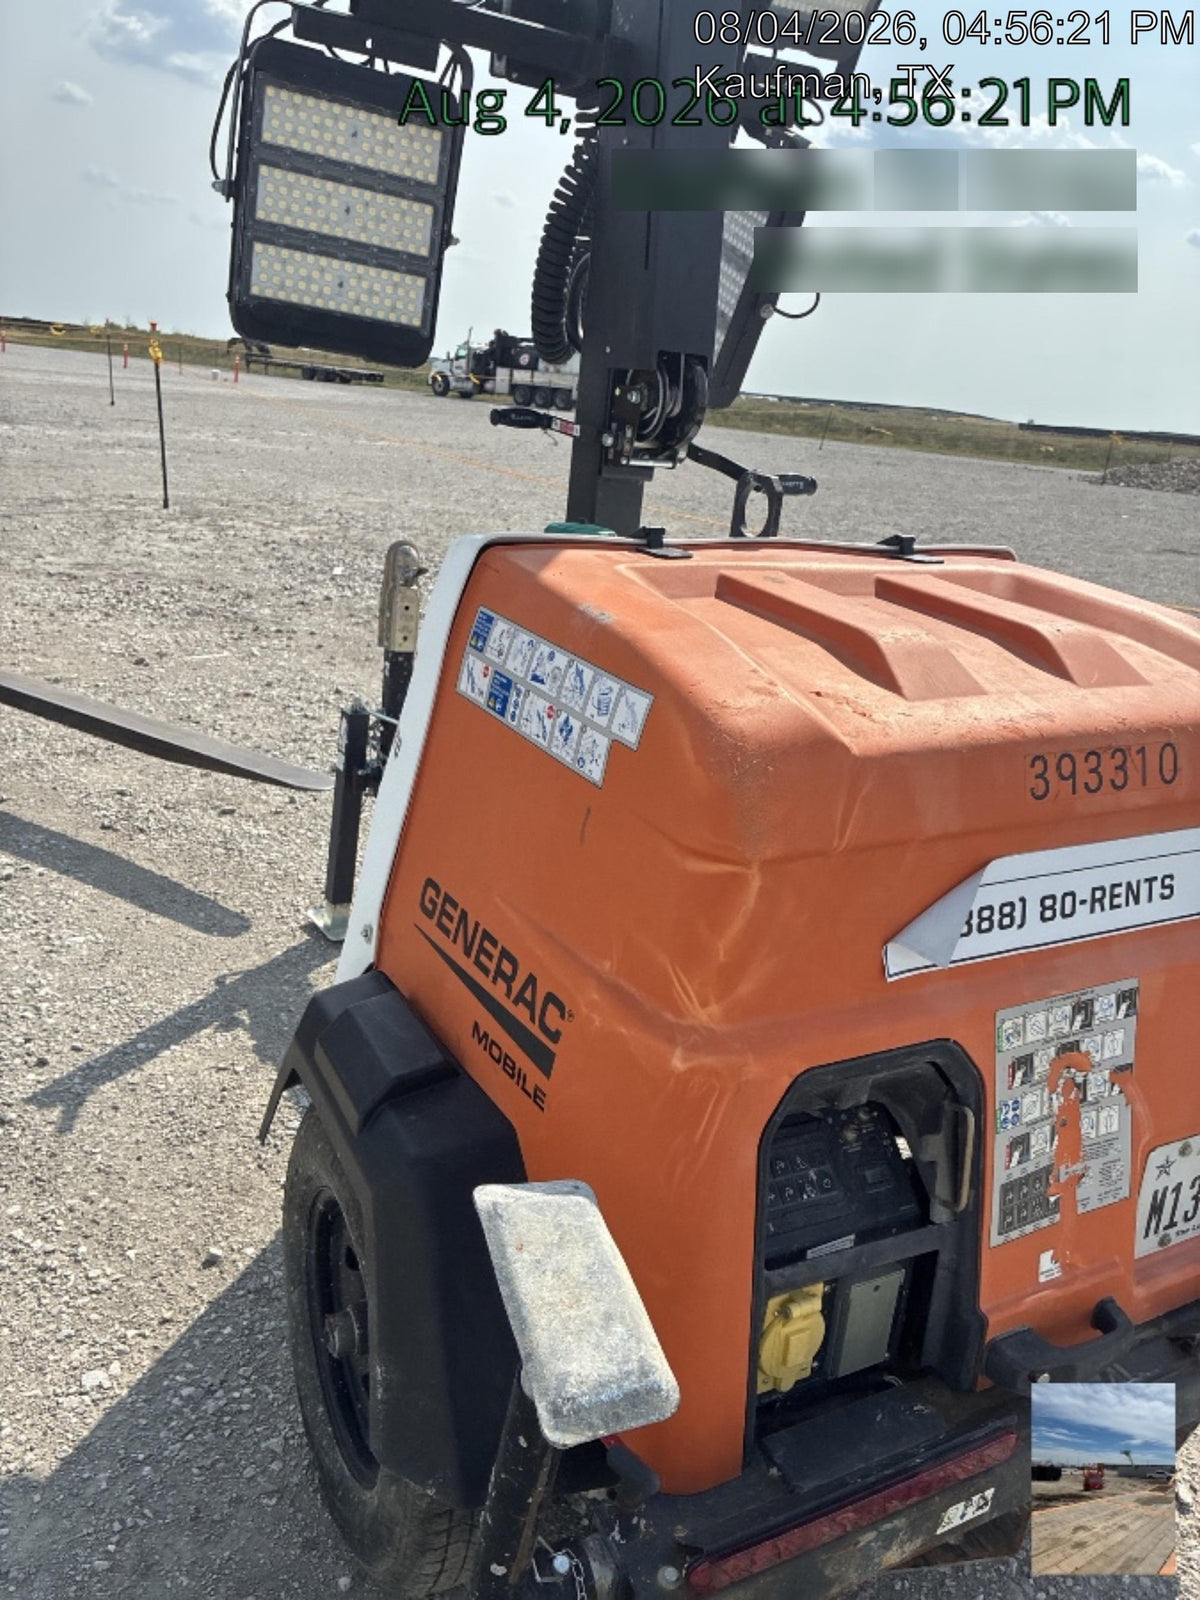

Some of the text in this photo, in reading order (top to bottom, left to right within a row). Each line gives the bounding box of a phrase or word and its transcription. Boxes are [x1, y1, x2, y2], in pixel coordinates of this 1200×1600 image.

[1029, 742, 1178, 801] 393310
[1039, 873, 1175, 924] 80-RENTS
[419, 876, 567, 1045] GENERAC
[471, 1019, 547, 1114] MOBILE
